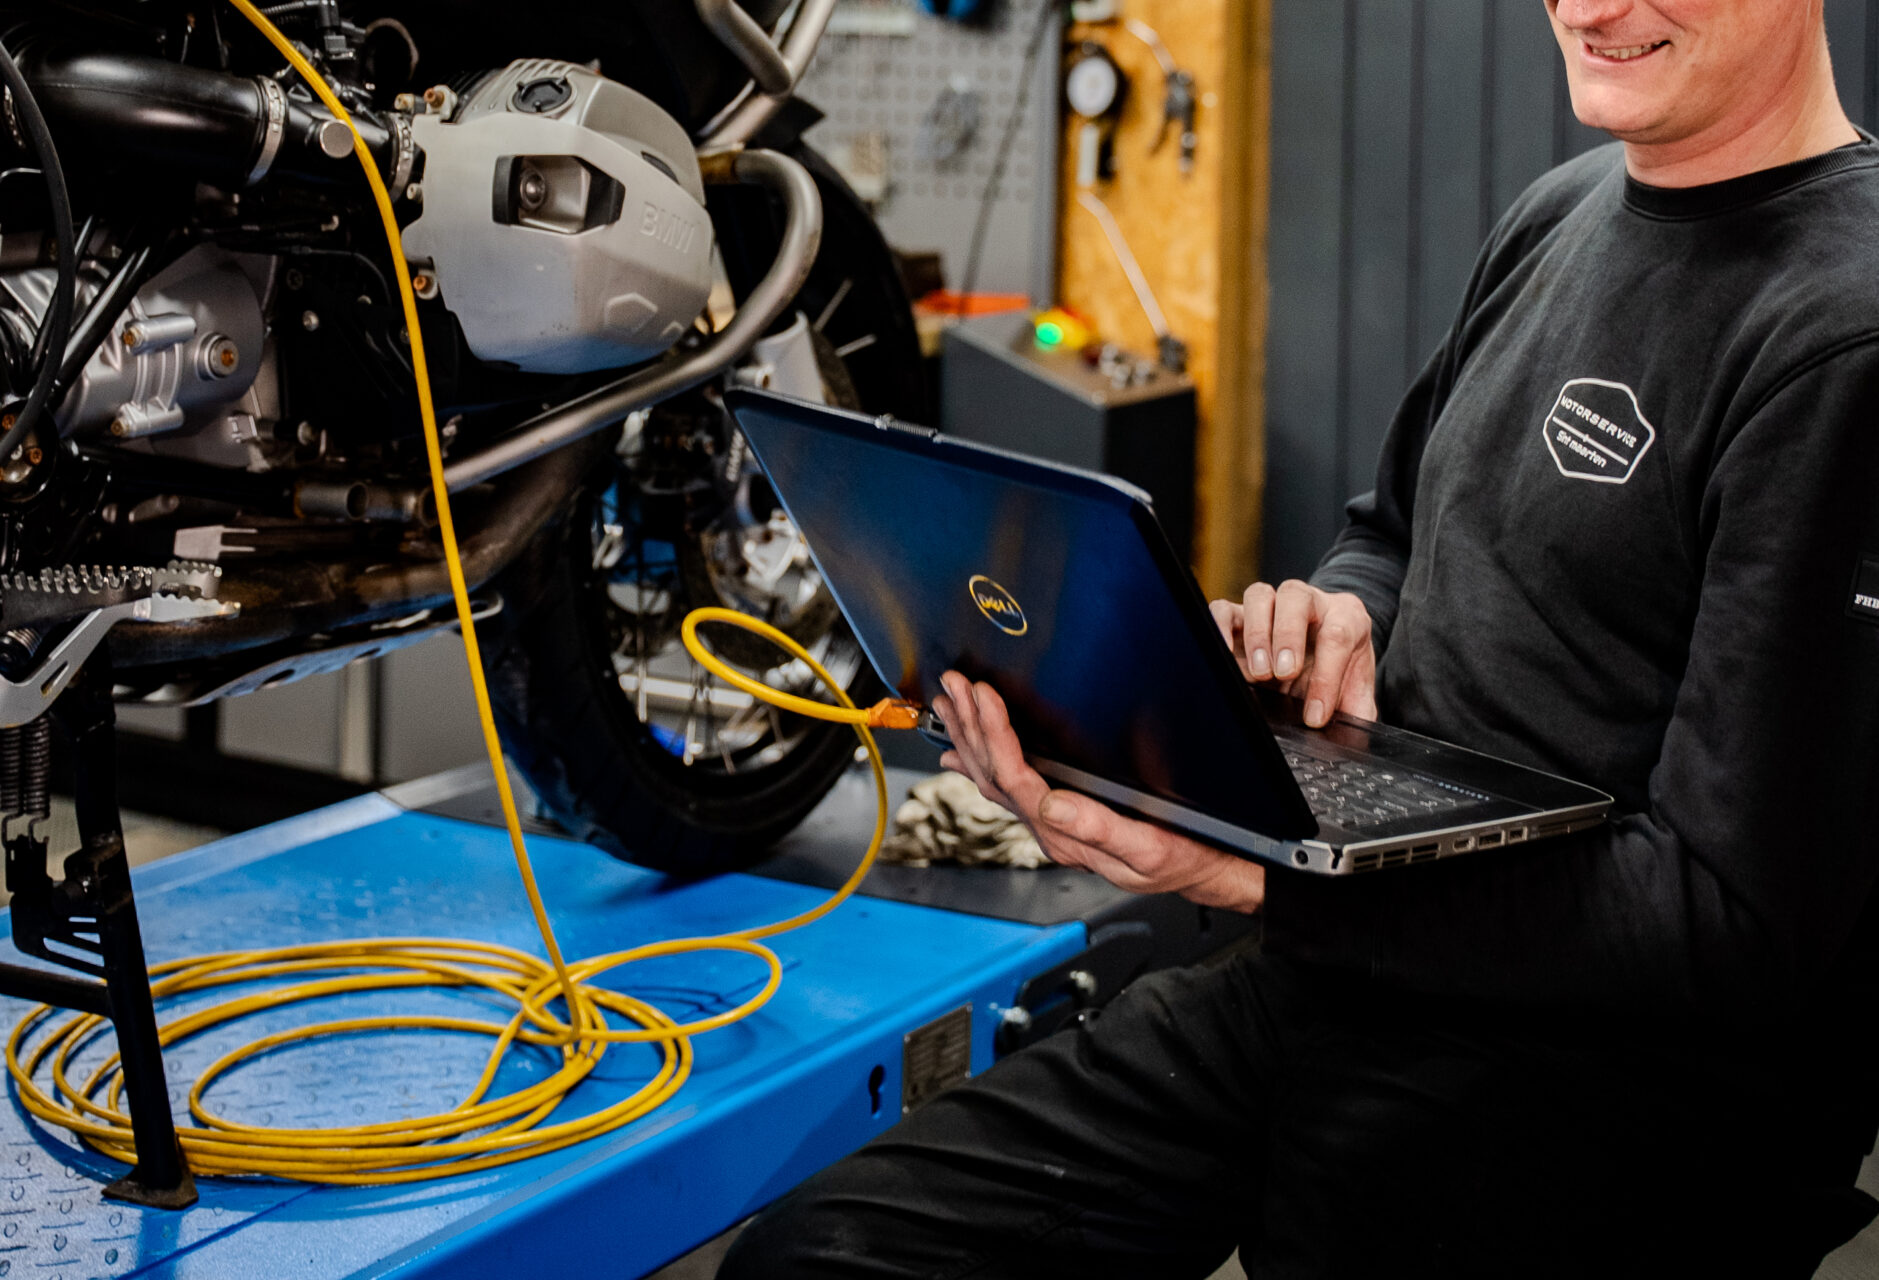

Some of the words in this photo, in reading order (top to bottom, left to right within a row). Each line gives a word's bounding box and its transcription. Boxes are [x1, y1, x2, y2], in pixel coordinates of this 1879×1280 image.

[640, 201, 700, 255] BMW
[1560, 395, 1637, 448] MOTORSERVICE
[1568, 438, 1607, 468] maarten
